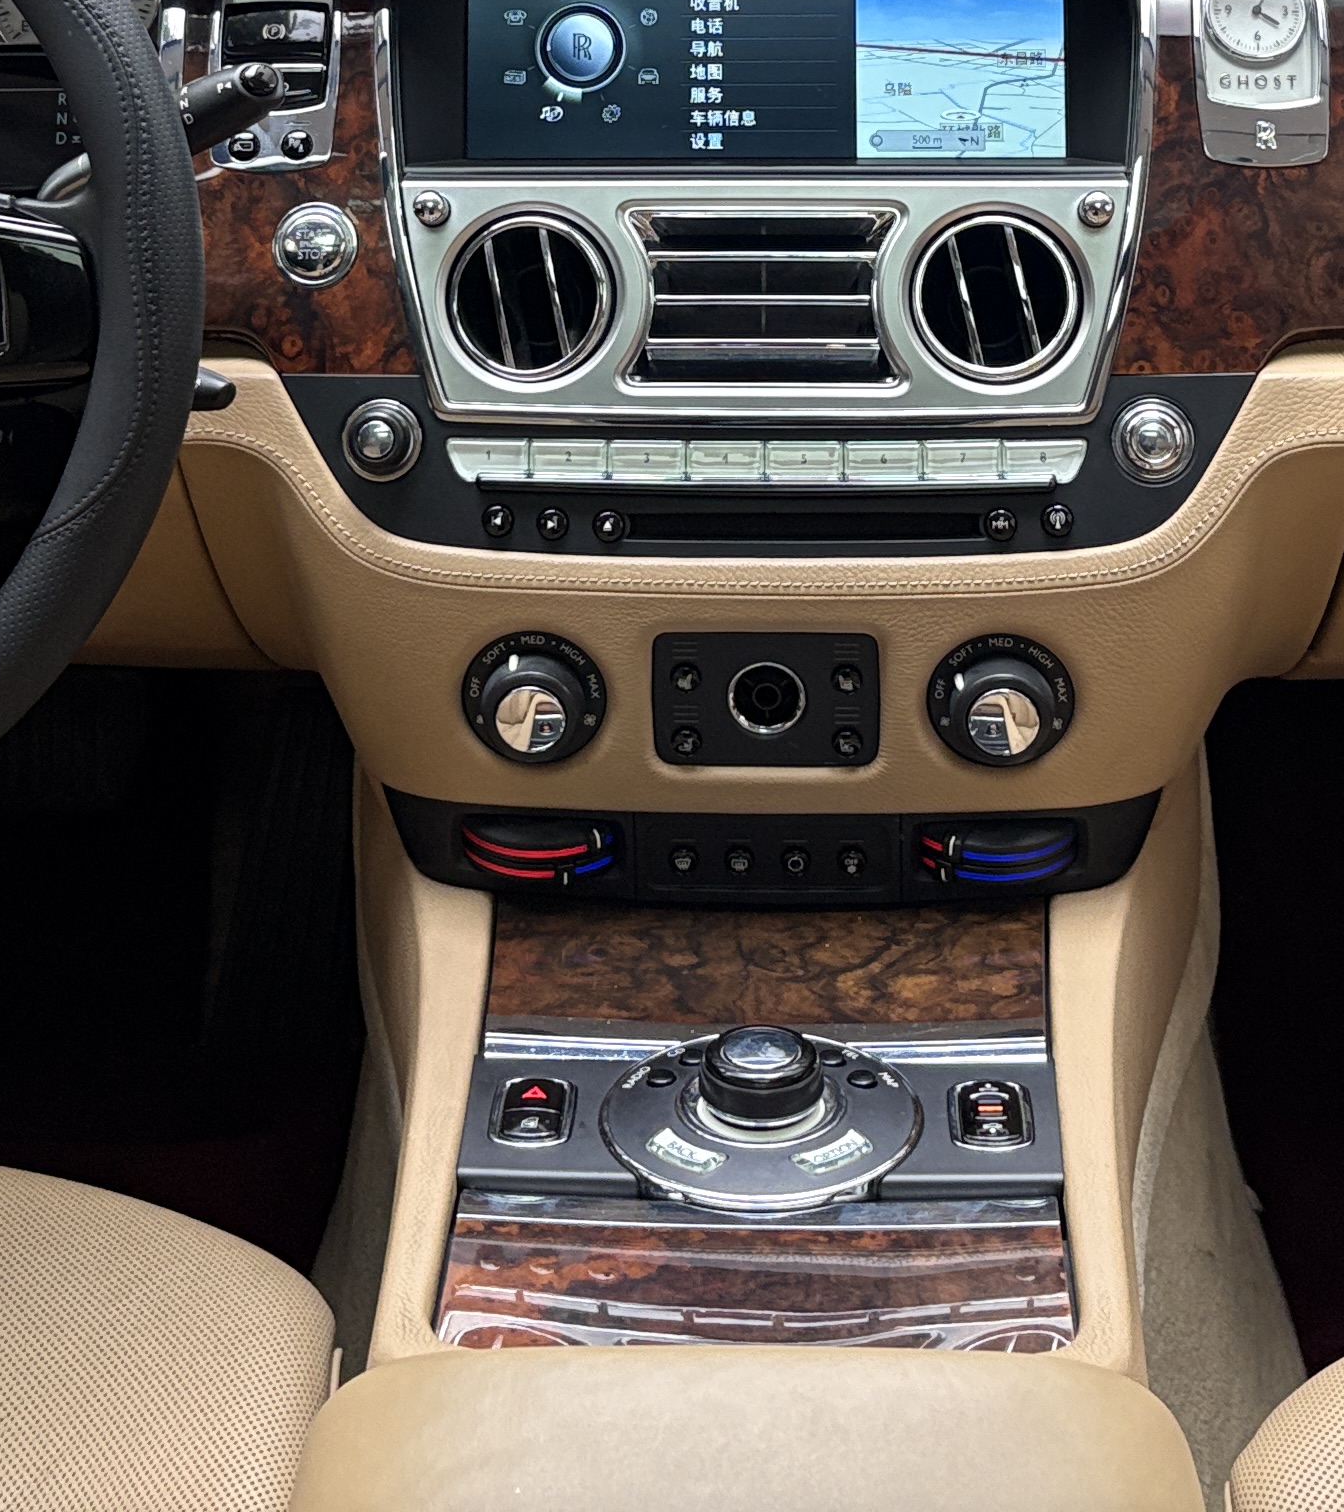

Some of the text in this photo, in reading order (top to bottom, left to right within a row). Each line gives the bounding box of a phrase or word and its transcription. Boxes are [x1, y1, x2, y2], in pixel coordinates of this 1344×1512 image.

[1224, 4, 1233, 17] 9
[1281, 5, 1289, 17] 3
[691, 18, 724, 35] 电话
[1254, 30, 1262, 41] 6
[689, 41, 724, 58] 导航
[689, 64, 724, 81] 地图
[1219, 72, 1298, 90] GHOST
[217, 82, 224, 94] P
[58, 93, 67, 106] R
[689, 87, 724, 104] 服务
[179, 98, 189, 110] N
[56, 112, 68, 124] N
[182, 113, 194, 125] D
[689, 110, 757, 127] 车辆信息
[56, 132, 68, 145] D
[689, 133, 724, 150] 设置
[912, 134, 943, 144] 500 m
[970, 136, 980, 146] N
[297, 250, 327, 260] STOP
[485, 450, 491, 461] 1
[565, 450, 573, 463] 2
[643, 452, 651, 463] 3
[800, 453, 808, 465] 5
[880, 453, 888, 465] 6
[960, 452, 967, 463] 7
[1039, 451, 1047, 463] 8
[520, 635, 546, 645] MED
[988, 637, 1014, 648] MED
[482, 641, 507, 665] SOFT
[559, 643, 587, 667] HIGH
[948, 644, 975, 667] SOFT
[1028, 646, 1055, 669] HIGH
[469, 676, 481, 698] OFF
[586, 673, 601, 699] MAX
[934, 678, 947, 700] OFF
[1054, 677, 1068, 703] MAX
[621, 1066, 651, 1089] RADIO
[667, 1141, 698, 1159] BACK
[814, 1138, 858, 1162] OPTION
